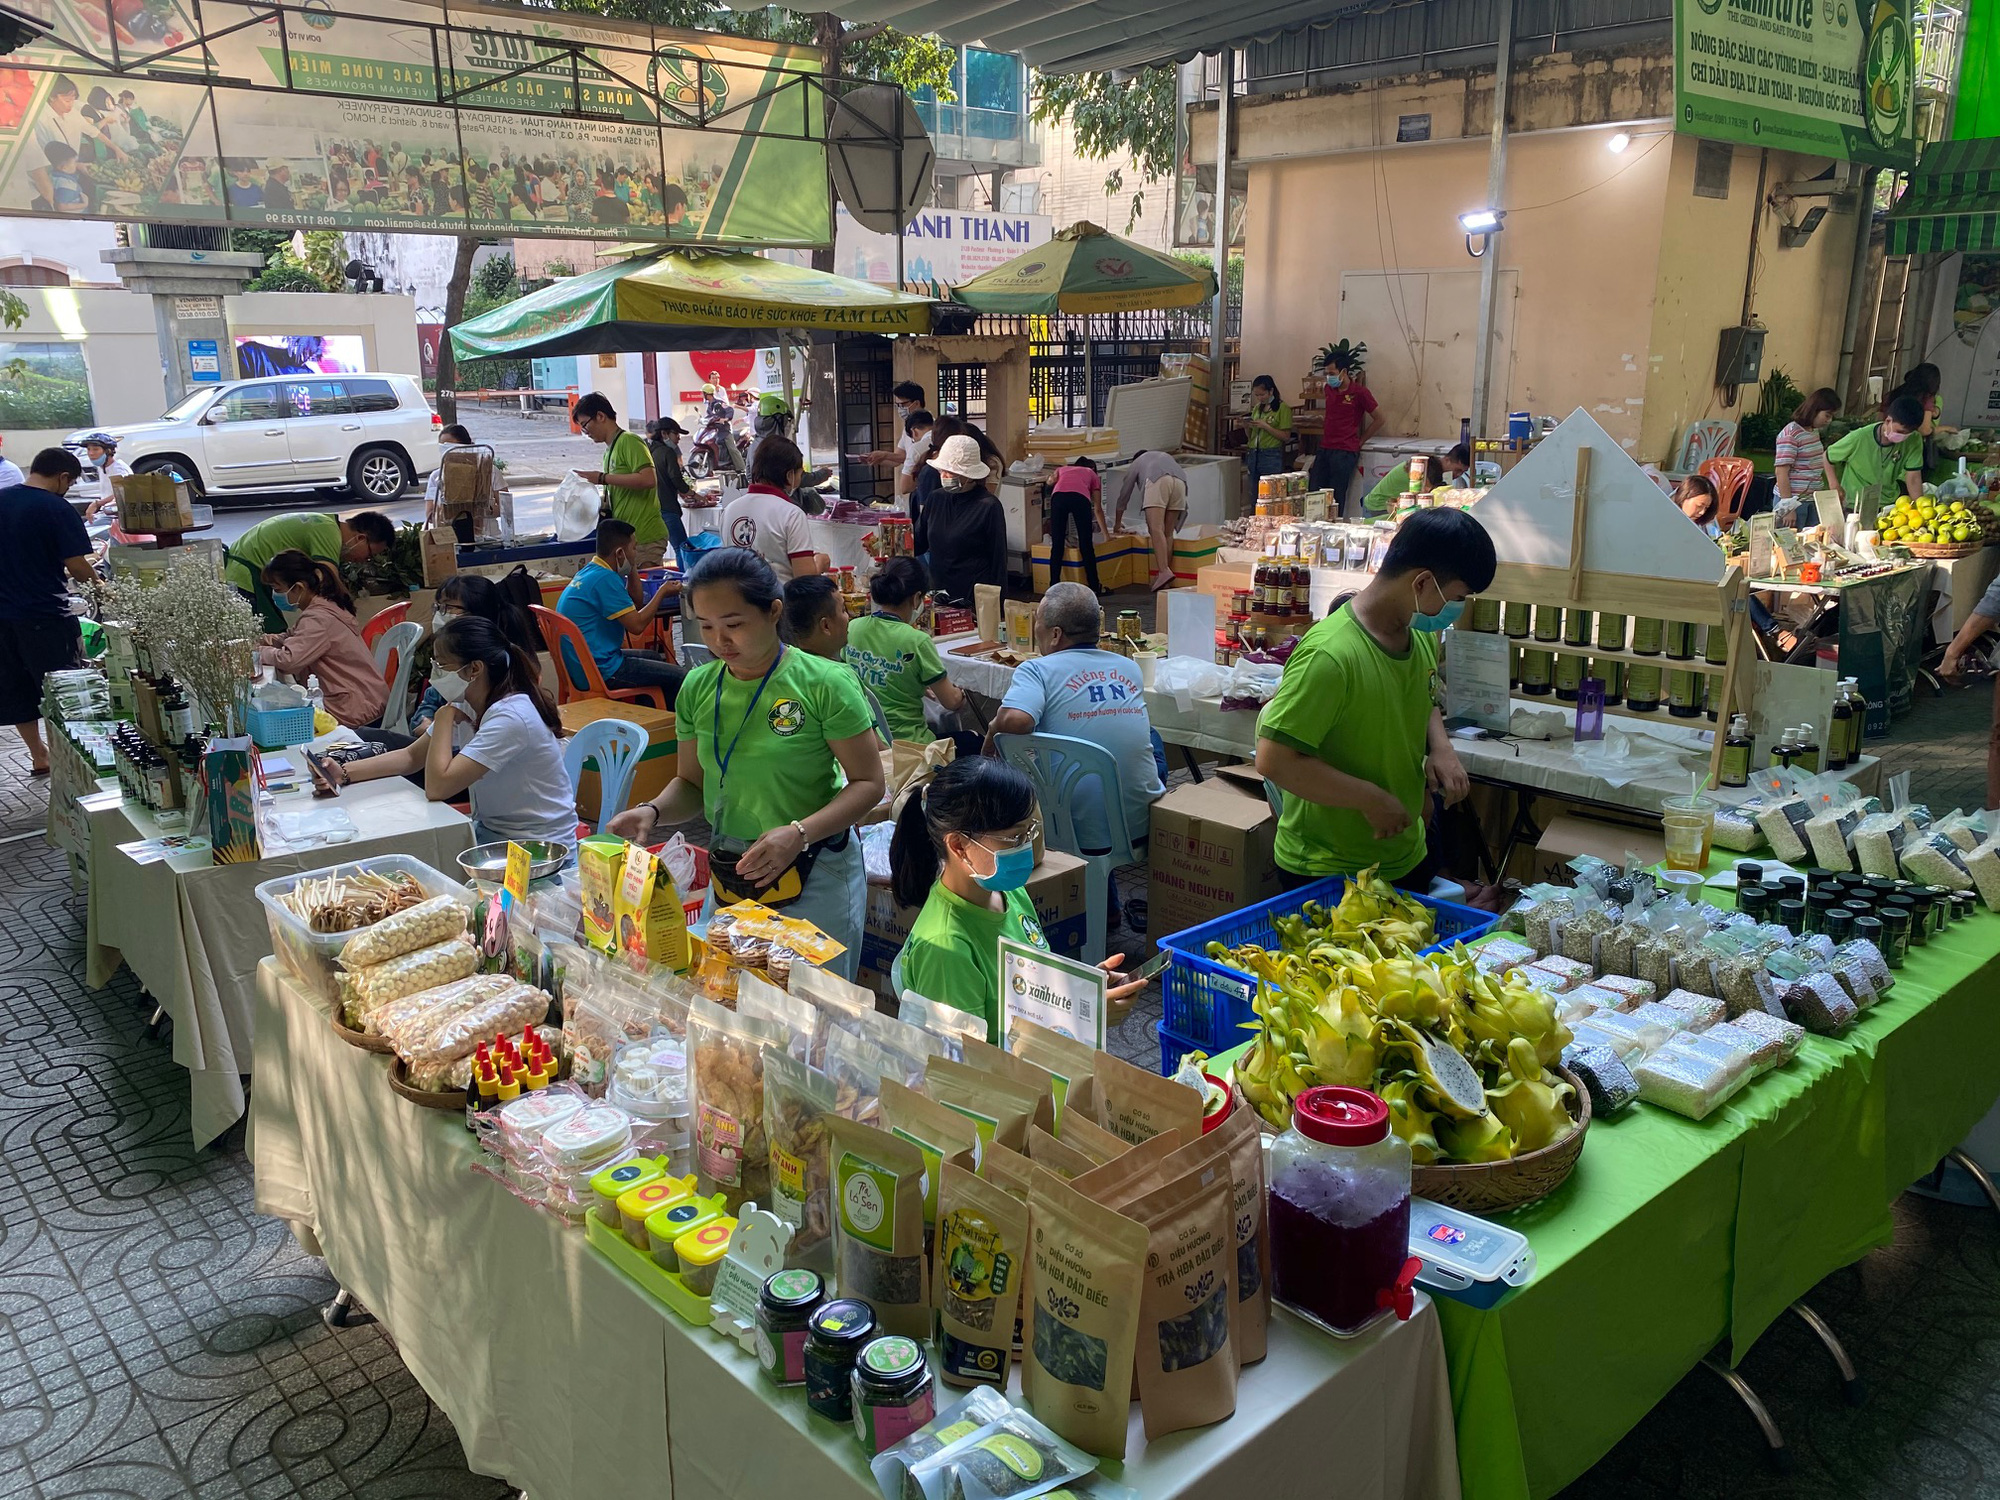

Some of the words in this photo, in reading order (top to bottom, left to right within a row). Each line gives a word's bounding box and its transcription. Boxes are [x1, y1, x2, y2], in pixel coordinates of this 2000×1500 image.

[1739, 14, 1759, 28] GREEN
[1690, 31, 1717, 55] NÔNG
[1718, 36, 1737, 64] ĐẶC
[1757, 46, 1774, 71] CÁC
[1774, 51, 1797, 75] VÙNG
[1730, 70, 1746, 94] ĐỊA
[1757, 76, 1770, 97] AN
[959, 216, 1031, 244] THANH
[660, 300, 691, 315] THỰC
[692, 298, 723, 317] PHẨM
[725, 302, 748, 319] BẢO
[750, 305, 764, 322] VỆ
[766, 306, 787, 321] SỨC
[822, 305, 866, 323] TÂM
[870, 308, 909, 324] LAN
[879, 657, 903, 673] Xanh
[869, 669, 888, 687] TẾ
[1067, 711, 1084, 721] Ngọt
[1152, 868, 1186, 891] HOÀNG
[1188, 880, 1235, 904] NGUYÊN
[884, 917, 909, 939] BÌNH
[1119, 1113, 1134, 1127] DIỆU
[1132, 1107, 1142, 1117] CƠ
[1142, 1110, 1151, 1120] SỞ
[715, 1119, 737, 1134] ANH
[1107, 1119, 1119, 1134] TRÀ
[781, 1159, 797, 1175] ANH
[861, 1195, 878, 1213] Sen
[1178, 1232, 1189, 1241] CƠ
[1064, 1243, 1075, 1253] CƠ
[1075, 1249, 1084, 1260] SỞ
[1169, 1243, 1186, 1262] DIỆU
[1186, 1231, 1212, 1253] HƯƠNG
[1049, 1246, 1065, 1263] DIỆU
[1064, 1256, 1092, 1280] HƯƠNG
[1155, 1268, 1176, 1288] TRÀ
[1195, 1246, 1211, 1267] ĐẬU
[728, 1271, 740, 1283] DIỆU
[739, 1278, 759, 1295] HƯƠNG
[1035, 1252, 1048, 1272] TRÀ
[1066, 1275, 1085, 1297] ĐẬU
[1085, 1287, 1109, 1308] BIẾC
